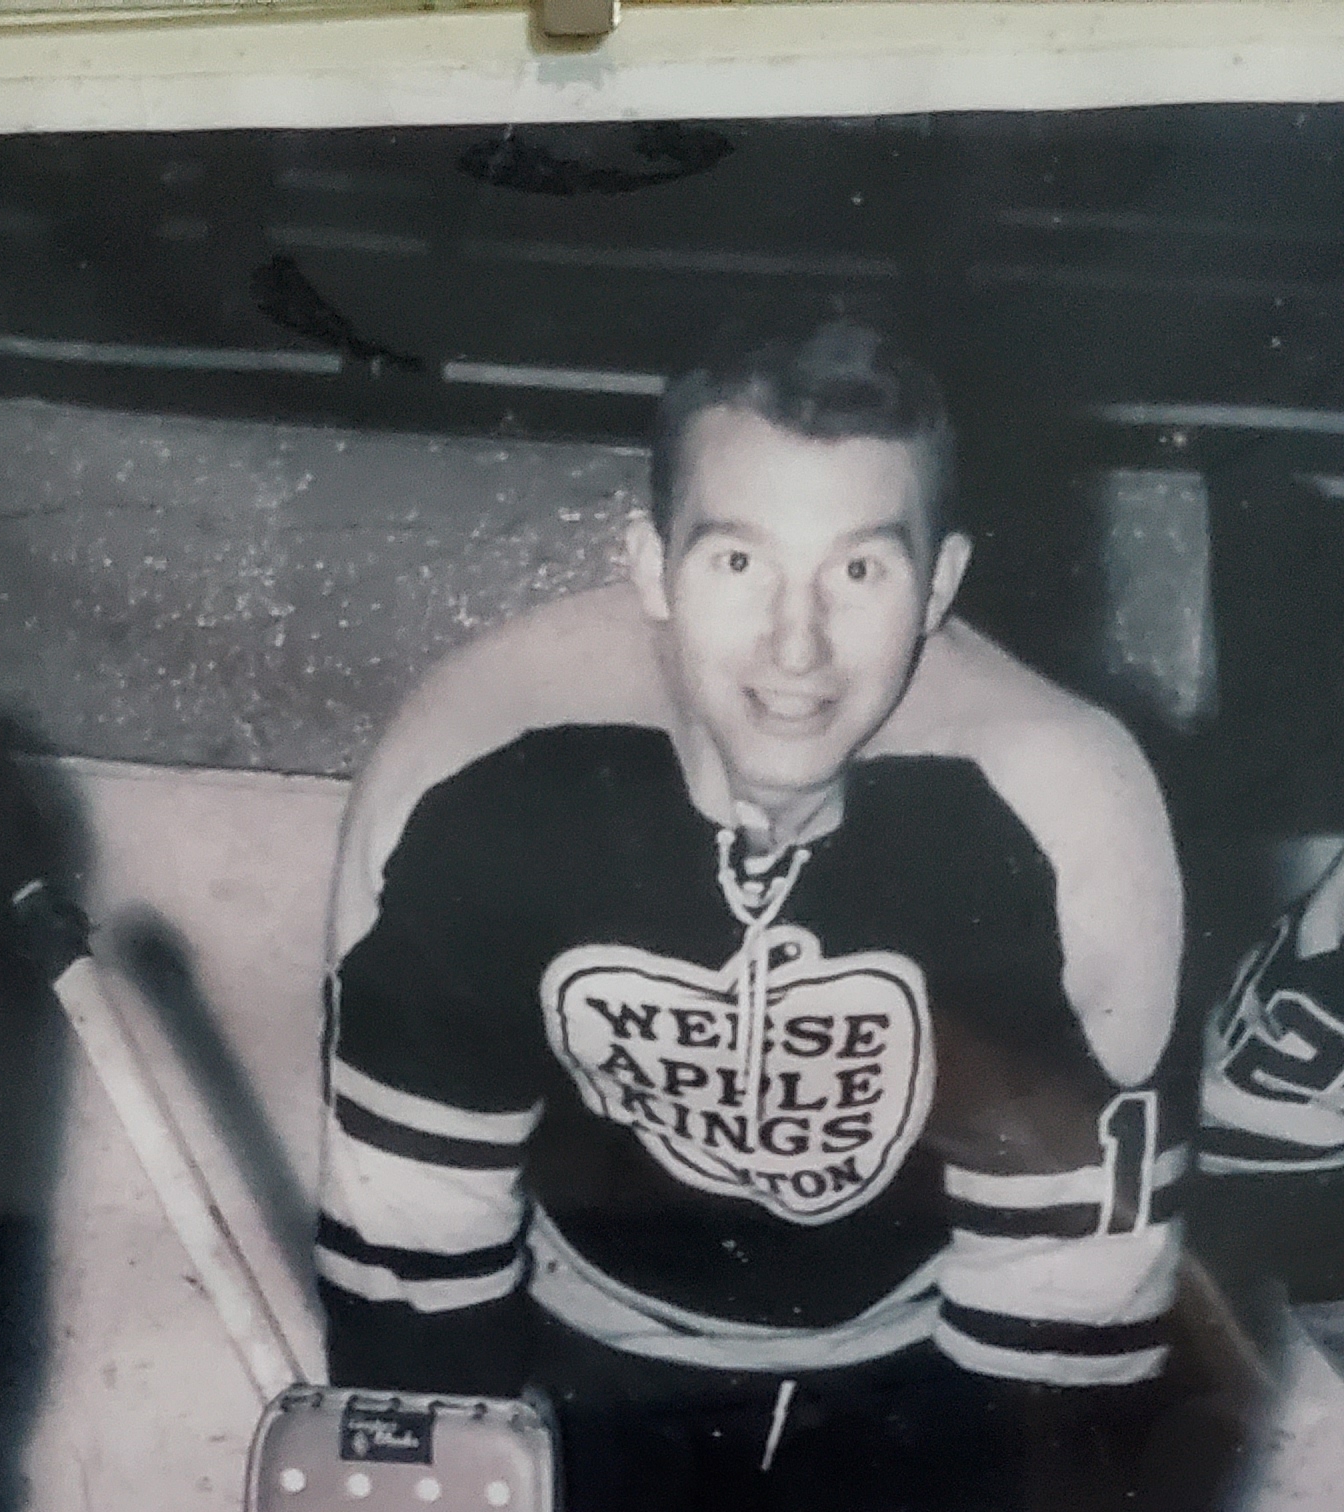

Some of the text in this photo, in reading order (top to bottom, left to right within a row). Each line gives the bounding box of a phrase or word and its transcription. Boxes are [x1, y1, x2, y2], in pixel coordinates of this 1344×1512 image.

[598, 1044, 883, 1111] APPLE
[619, 1087, 874, 1157] KINGS
[1099, 1091, 1157, 1237] 1
